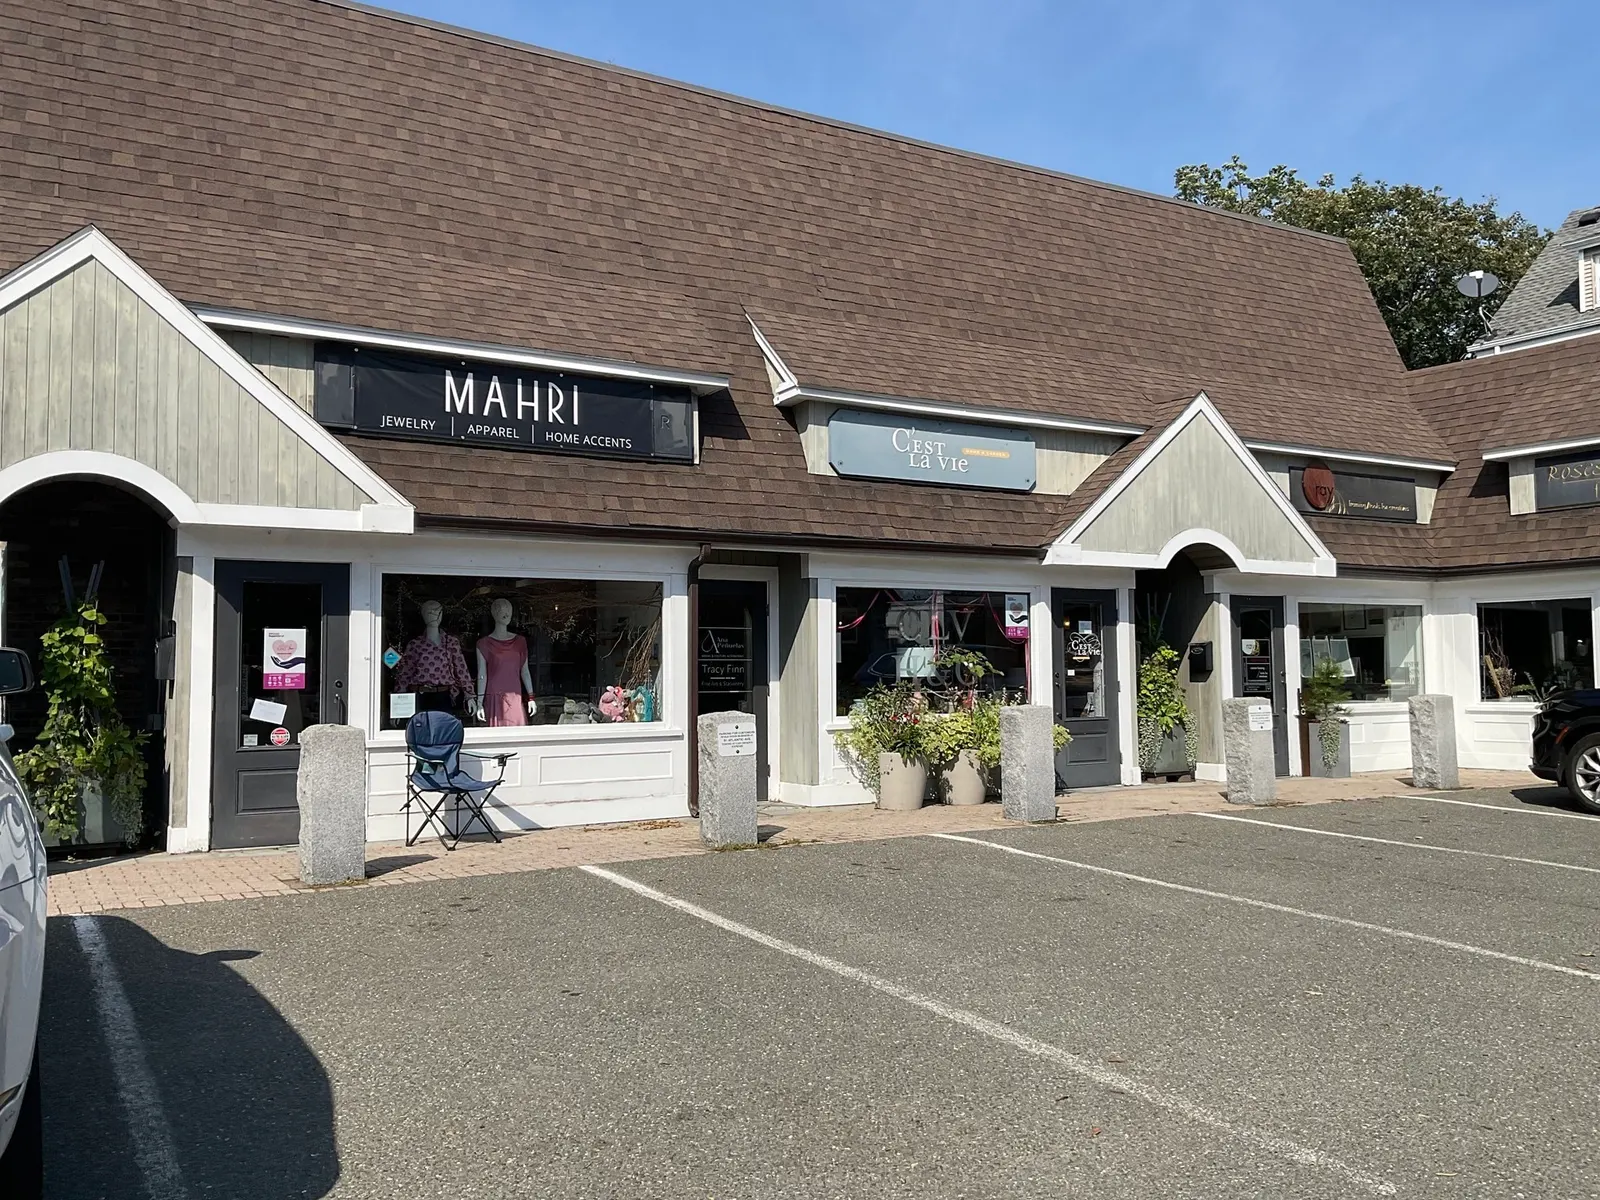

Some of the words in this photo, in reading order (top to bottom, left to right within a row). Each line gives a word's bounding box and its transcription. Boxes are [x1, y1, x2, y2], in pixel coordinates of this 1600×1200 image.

[445, 370, 579, 425] MAHRI
[380, 415, 436, 431] JEWELRY
[467, 424, 520, 439] APPAREL
[545, 431, 580, 445] HOME
[583, 434, 632, 449] ACCENTS
[892, 426, 946, 456] C'EST
[701, 664, 725, 675] Tracy
[726, 664, 745, 674] Finn
